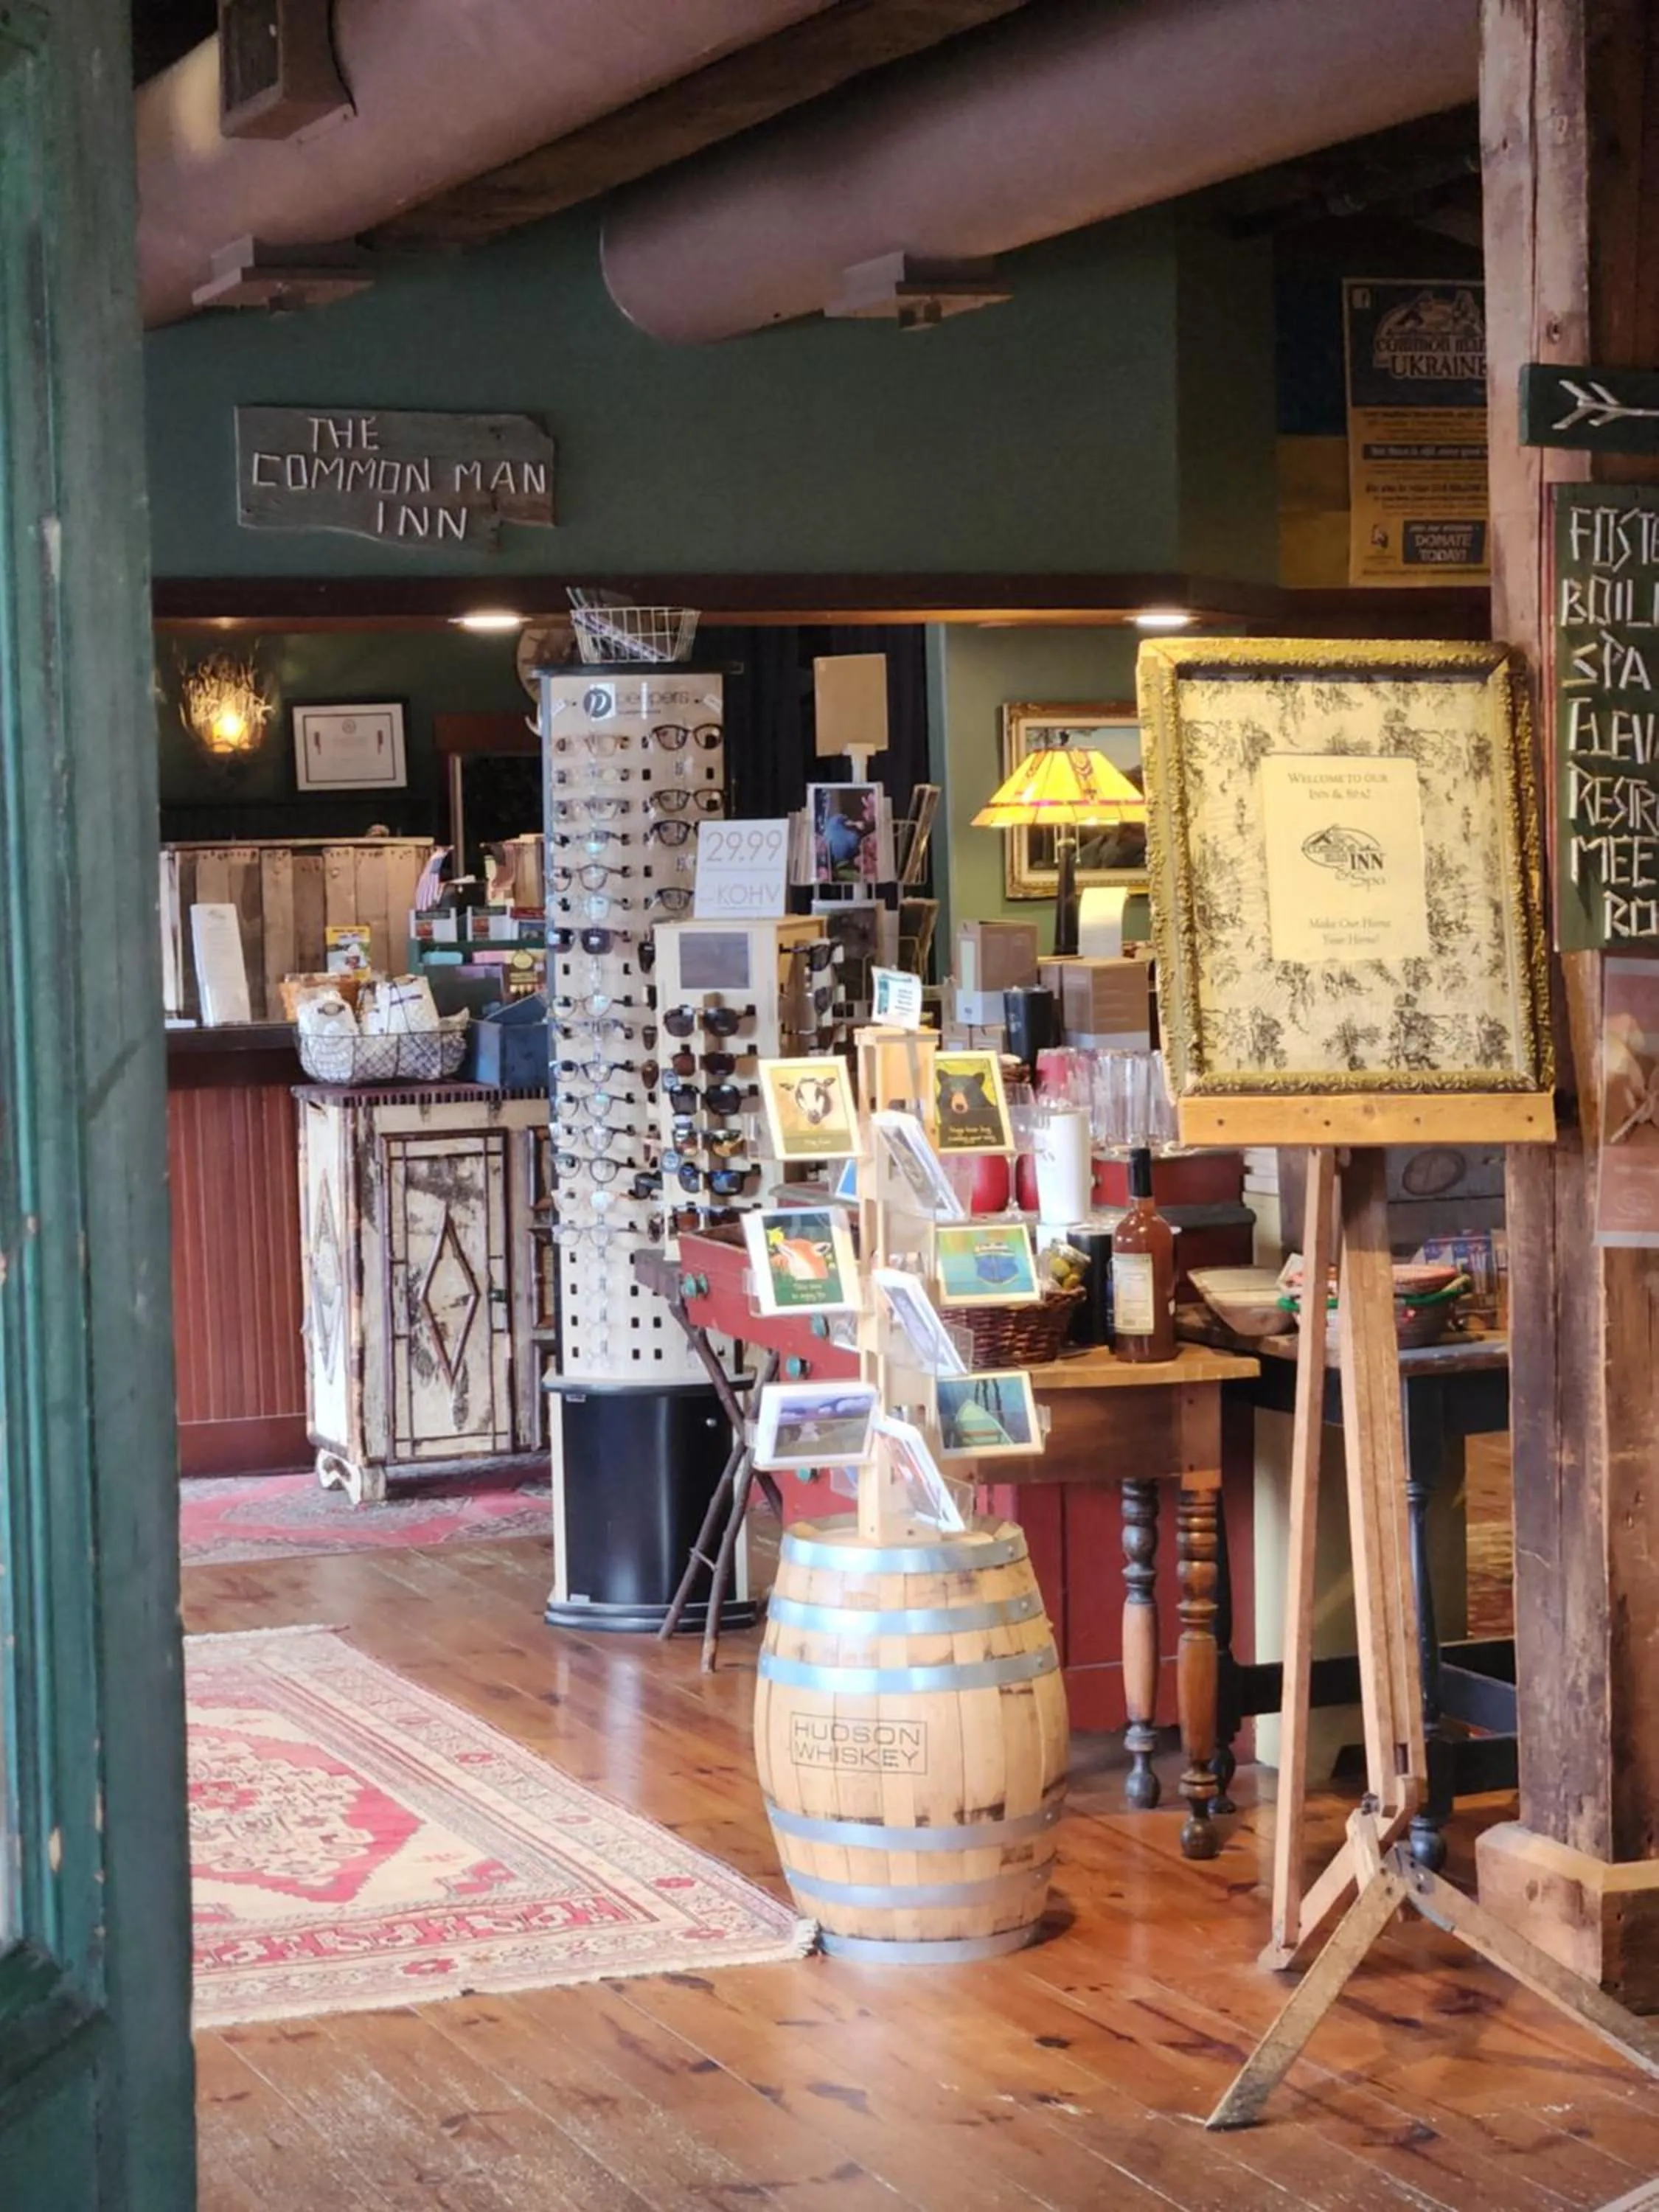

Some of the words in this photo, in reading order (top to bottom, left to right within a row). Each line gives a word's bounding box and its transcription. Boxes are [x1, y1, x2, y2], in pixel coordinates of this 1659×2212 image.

[1391, 355, 1486, 377] UKRAINE
[308, 417, 380, 453] THE
[252, 452, 430, 494] COMMON
[455, 461, 545, 495] MAN
[378, 501, 467, 540] INN
[1415, 534, 1472, 548] DONATE
[1561, 575, 1659, 627] BOIL
[1561, 629, 1652, 691] SPA
[1566, 698, 1659, 765] ELEV
[1566, 761, 1659, 836] RESTR
[706, 830, 783, 862] 29.99
[1350, 853, 1386, 872] INN
[794, 1719, 920, 1746] HUDSON
[794, 1740, 919, 1768] WHISKEY
